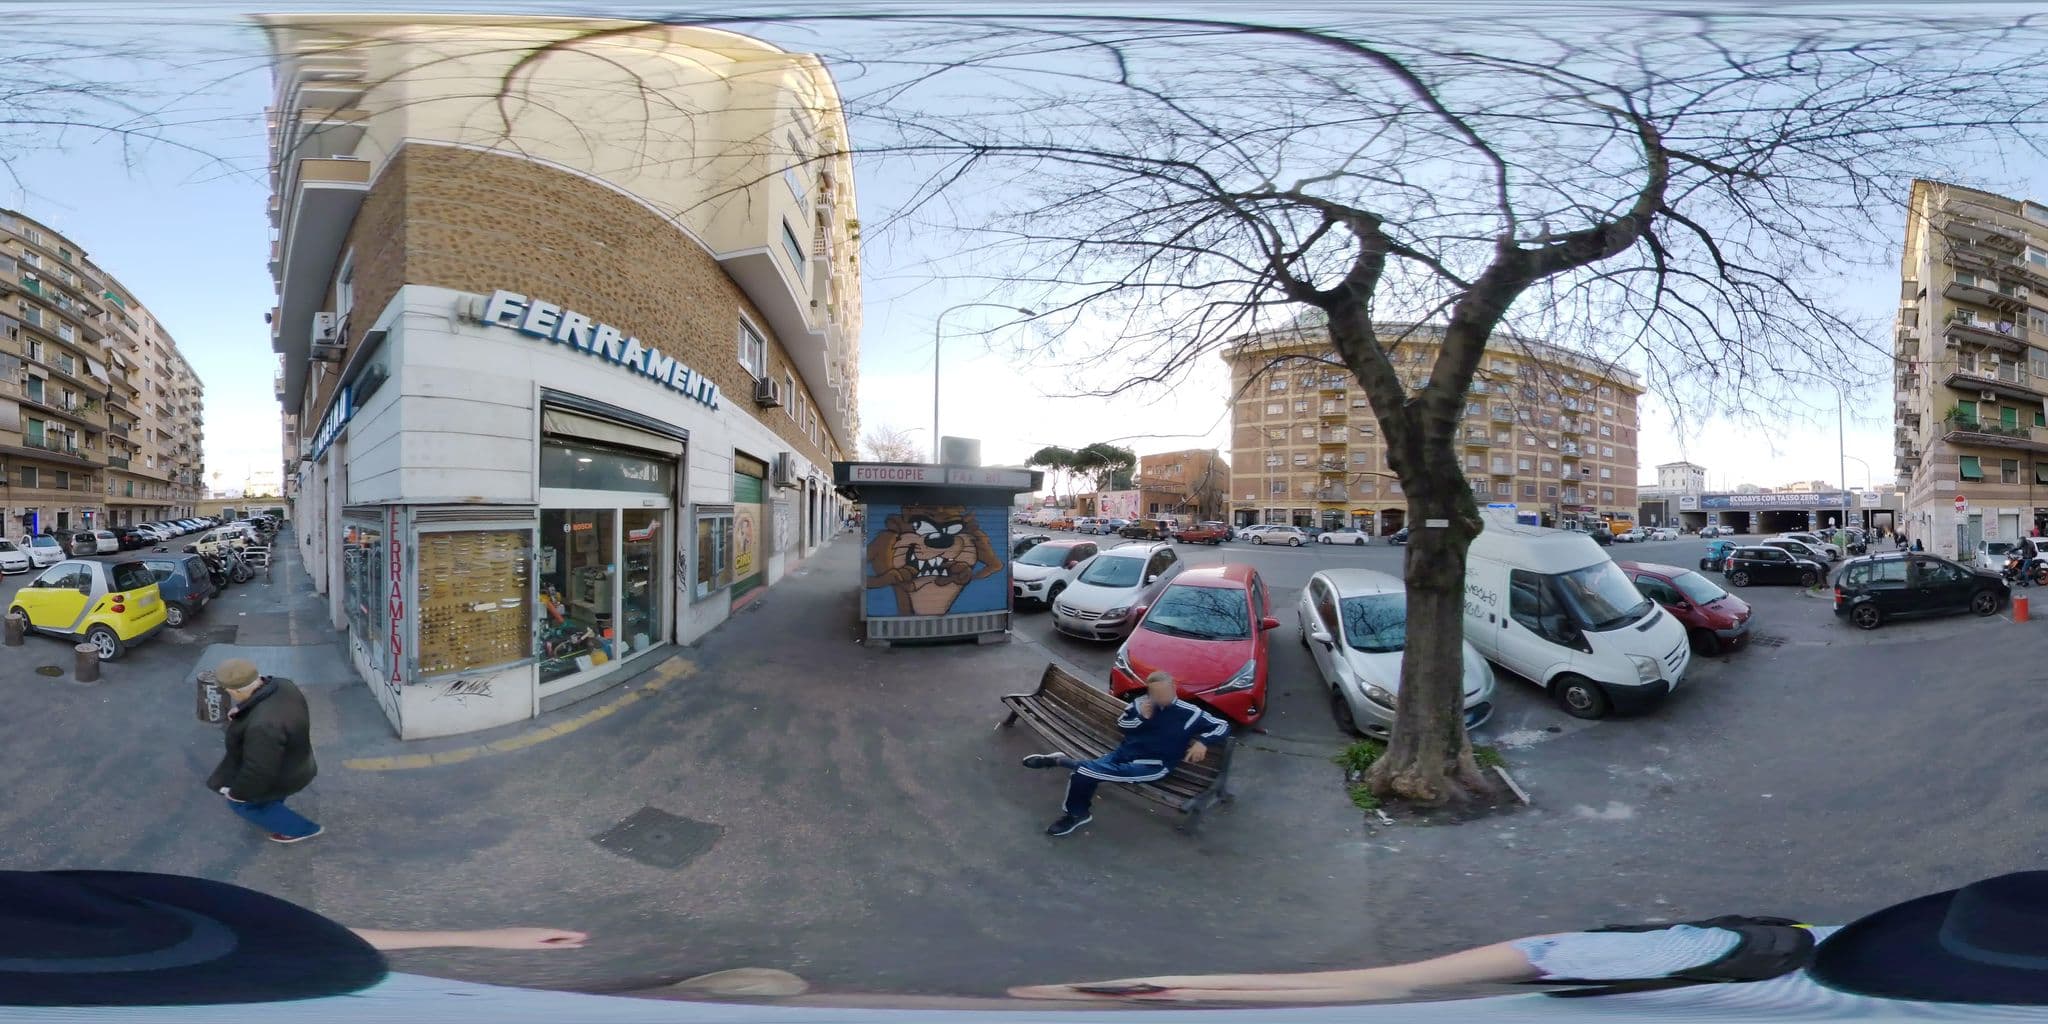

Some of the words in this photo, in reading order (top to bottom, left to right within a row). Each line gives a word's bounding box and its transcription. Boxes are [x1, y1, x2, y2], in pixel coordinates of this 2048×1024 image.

[484, 289, 722, 410] FERRAMENTA
[857, 468, 924, 481] FOTOCOPIE
[1729, 495, 1760, 503] ECODAYS
[389, 506, 403, 686] FERRAMENTA
